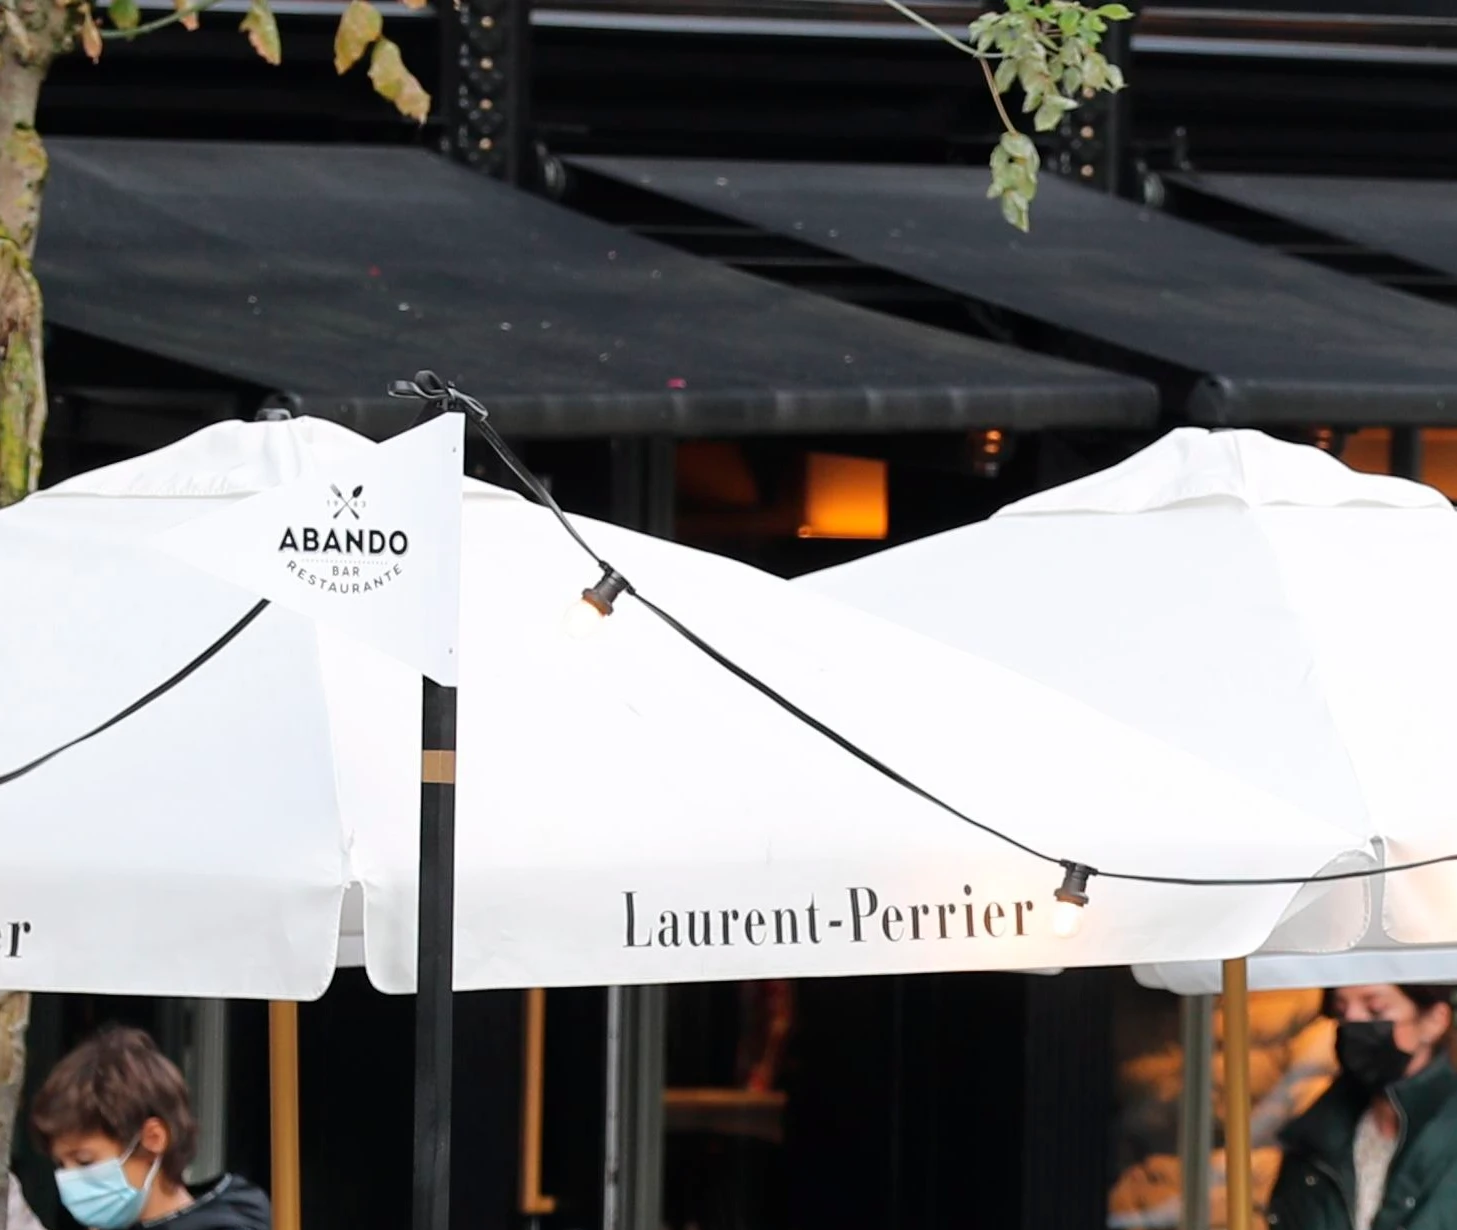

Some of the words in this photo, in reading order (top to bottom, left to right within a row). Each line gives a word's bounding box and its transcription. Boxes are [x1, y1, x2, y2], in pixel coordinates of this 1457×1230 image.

[278, 526, 408, 555] ABANDO
[286, 559, 402, 594] RESTAURANTE
[332, 565, 360, 577] BAR
[622, 884, 1035, 948] Laurent-Perrier
